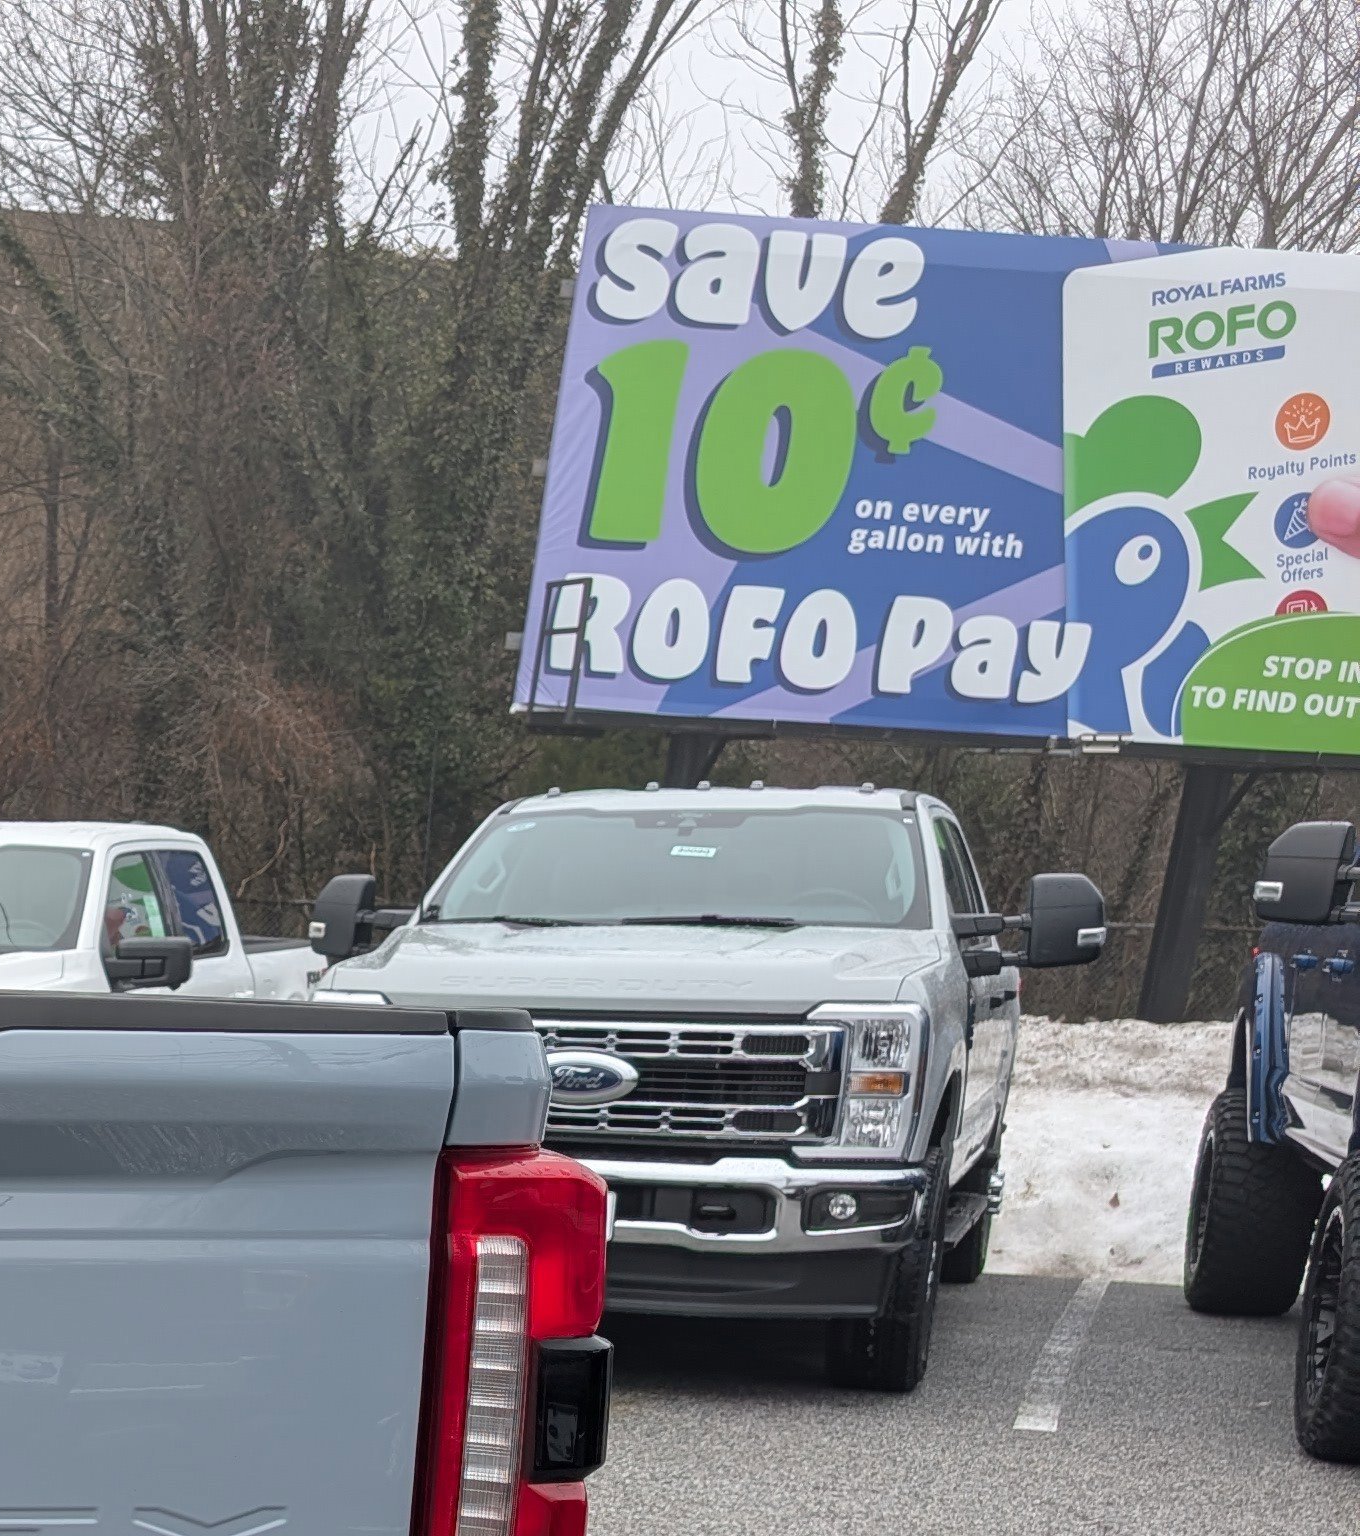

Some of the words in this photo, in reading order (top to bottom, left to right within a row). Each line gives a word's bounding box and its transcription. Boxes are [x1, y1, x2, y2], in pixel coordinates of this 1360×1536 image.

[1152, 283, 1219, 306] ROYAL
[1220, 272, 1286, 297] FARMS
[1148, 300, 1297, 359] ROFO
[1174, 350, 1264, 374] REWARDS
[1248, 460, 1305, 480] Royalty
[1310, 453, 1357, 471] Points
[855, 499, 893, 521] on
[902, 502, 991, 533] every
[847, 525, 944, 555] gallon
[955, 531, 1024, 559] with
[1276, 547, 1329, 574] Special
[1281, 567, 1324, 584] Offers
[549, 573, 858, 691] ROFO
[878, 595, 1093, 704] Pay
[1262, 655, 1332, 681] STOP
[1191, 685, 1226, 710] TO
[1232, 688, 1297, 715] FIND
[1304, 693, 1360, 720] OUT
[552, 1065, 604, 1089] Ford
